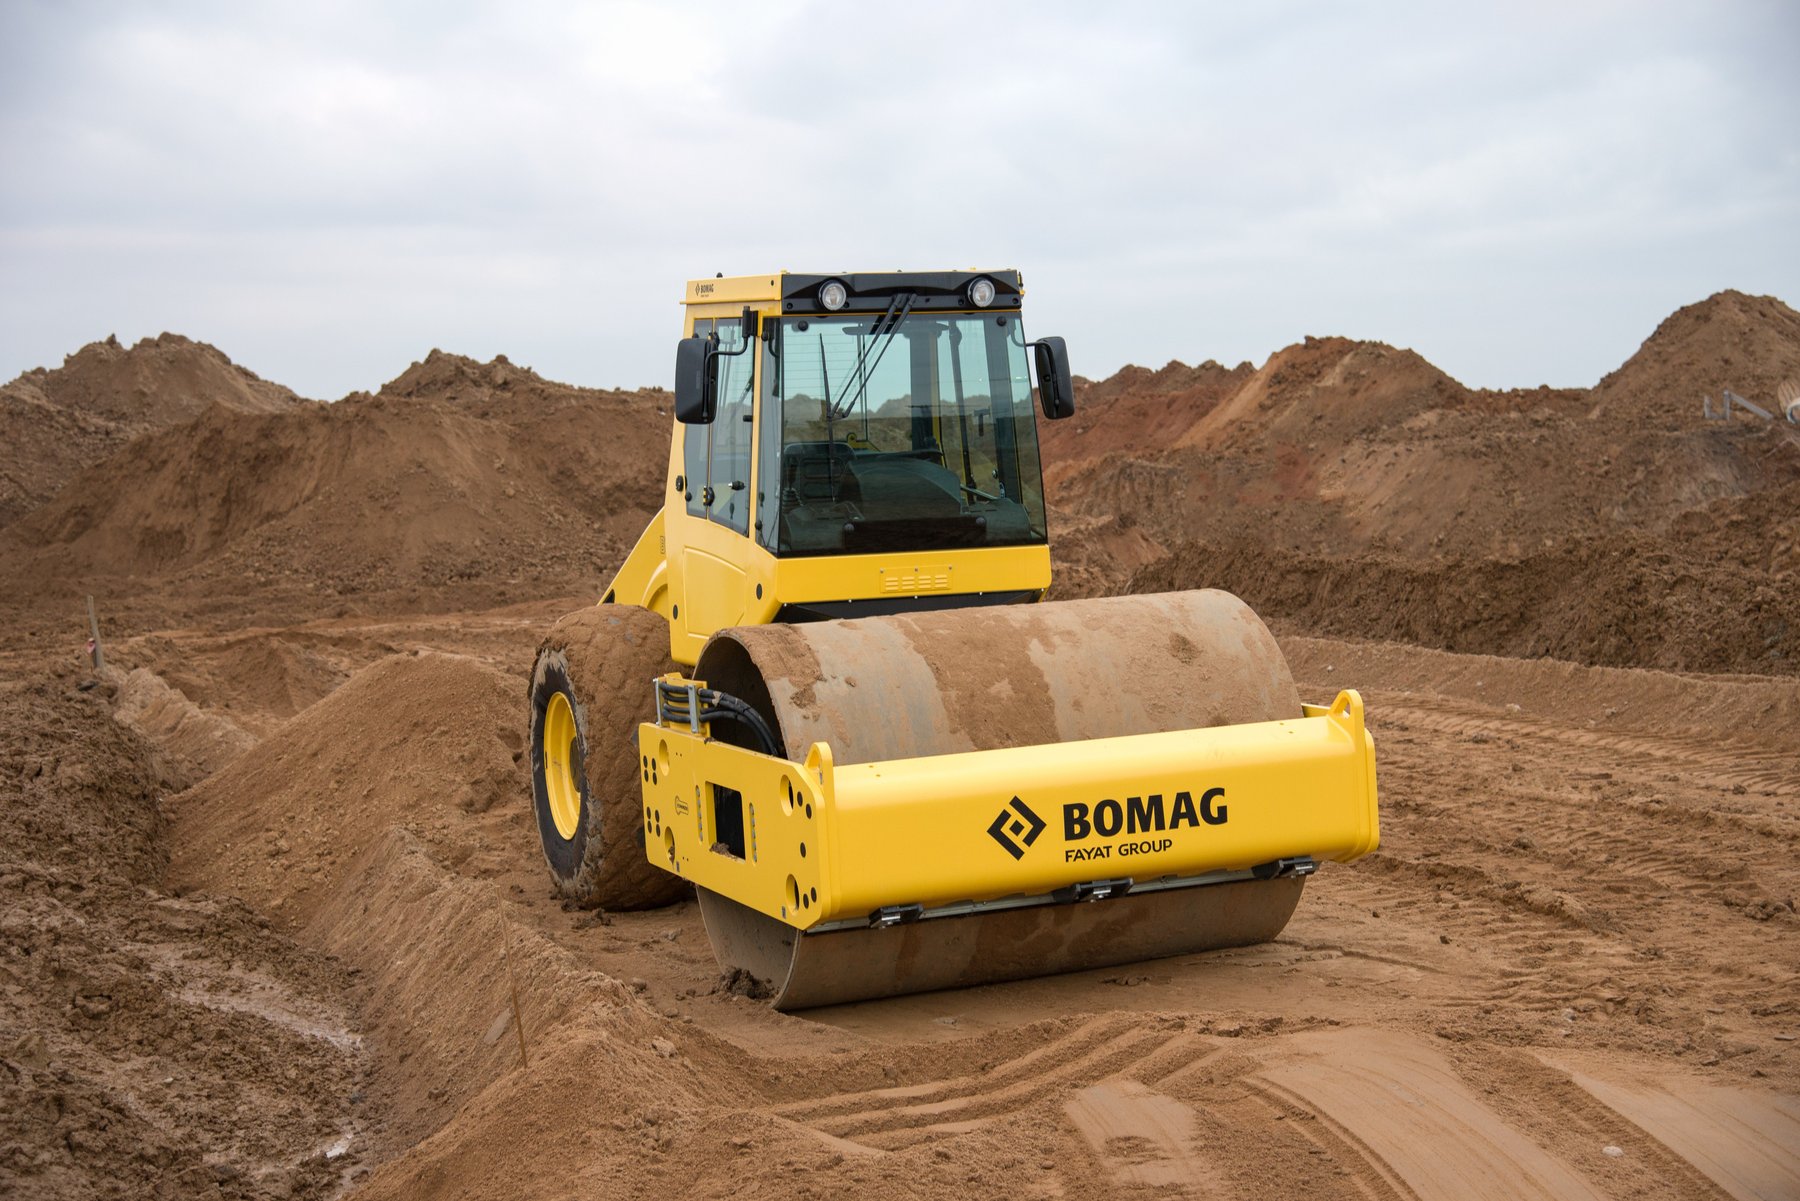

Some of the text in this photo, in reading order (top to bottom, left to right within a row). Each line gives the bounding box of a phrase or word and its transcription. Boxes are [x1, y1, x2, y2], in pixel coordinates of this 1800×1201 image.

[1063, 787, 1228, 841] BOMAG
[1065, 838, 1173, 863] FAYAT GROUP
